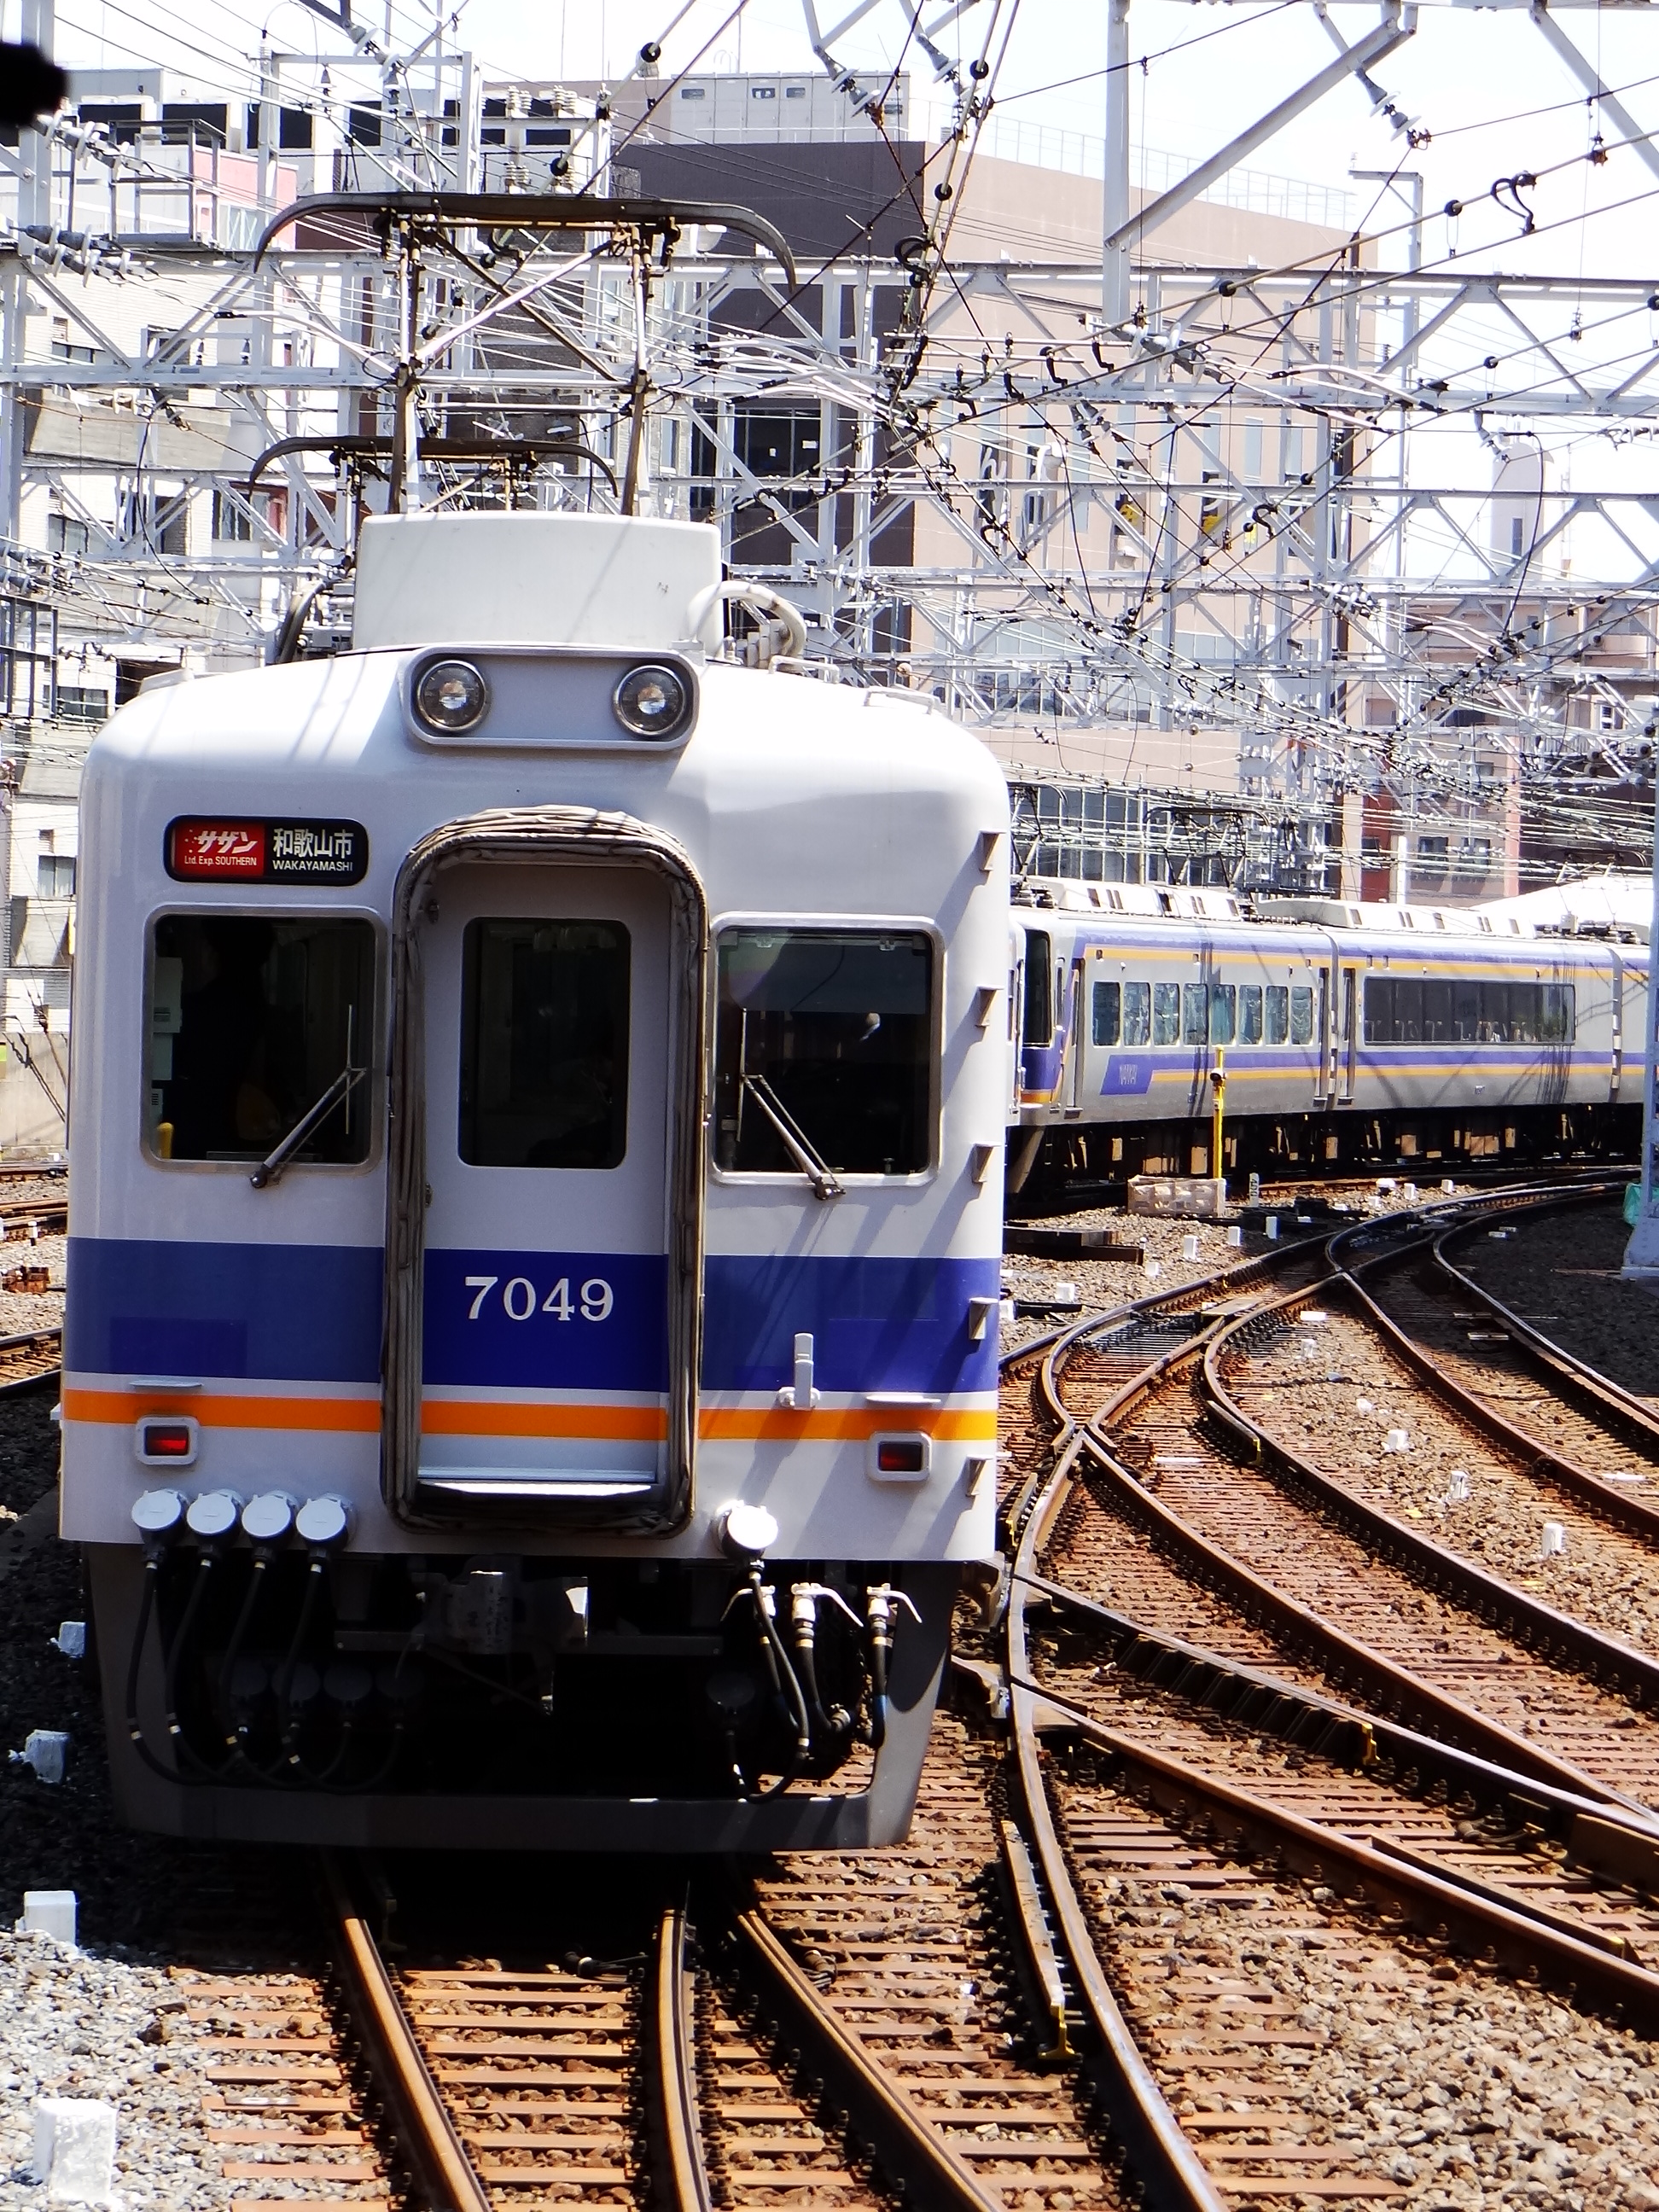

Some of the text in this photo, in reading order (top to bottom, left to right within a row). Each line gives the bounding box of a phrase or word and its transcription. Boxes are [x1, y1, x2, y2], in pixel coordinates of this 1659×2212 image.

[197, 830, 258, 853] サザン
[273, 828, 354, 859] 和歌山市
[184, 855, 257, 866] Ltd. Exp. SOUTHERN
[273, 859, 353, 871] WAKAYAMASHI
[465, 1277, 614, 1321] 7049
